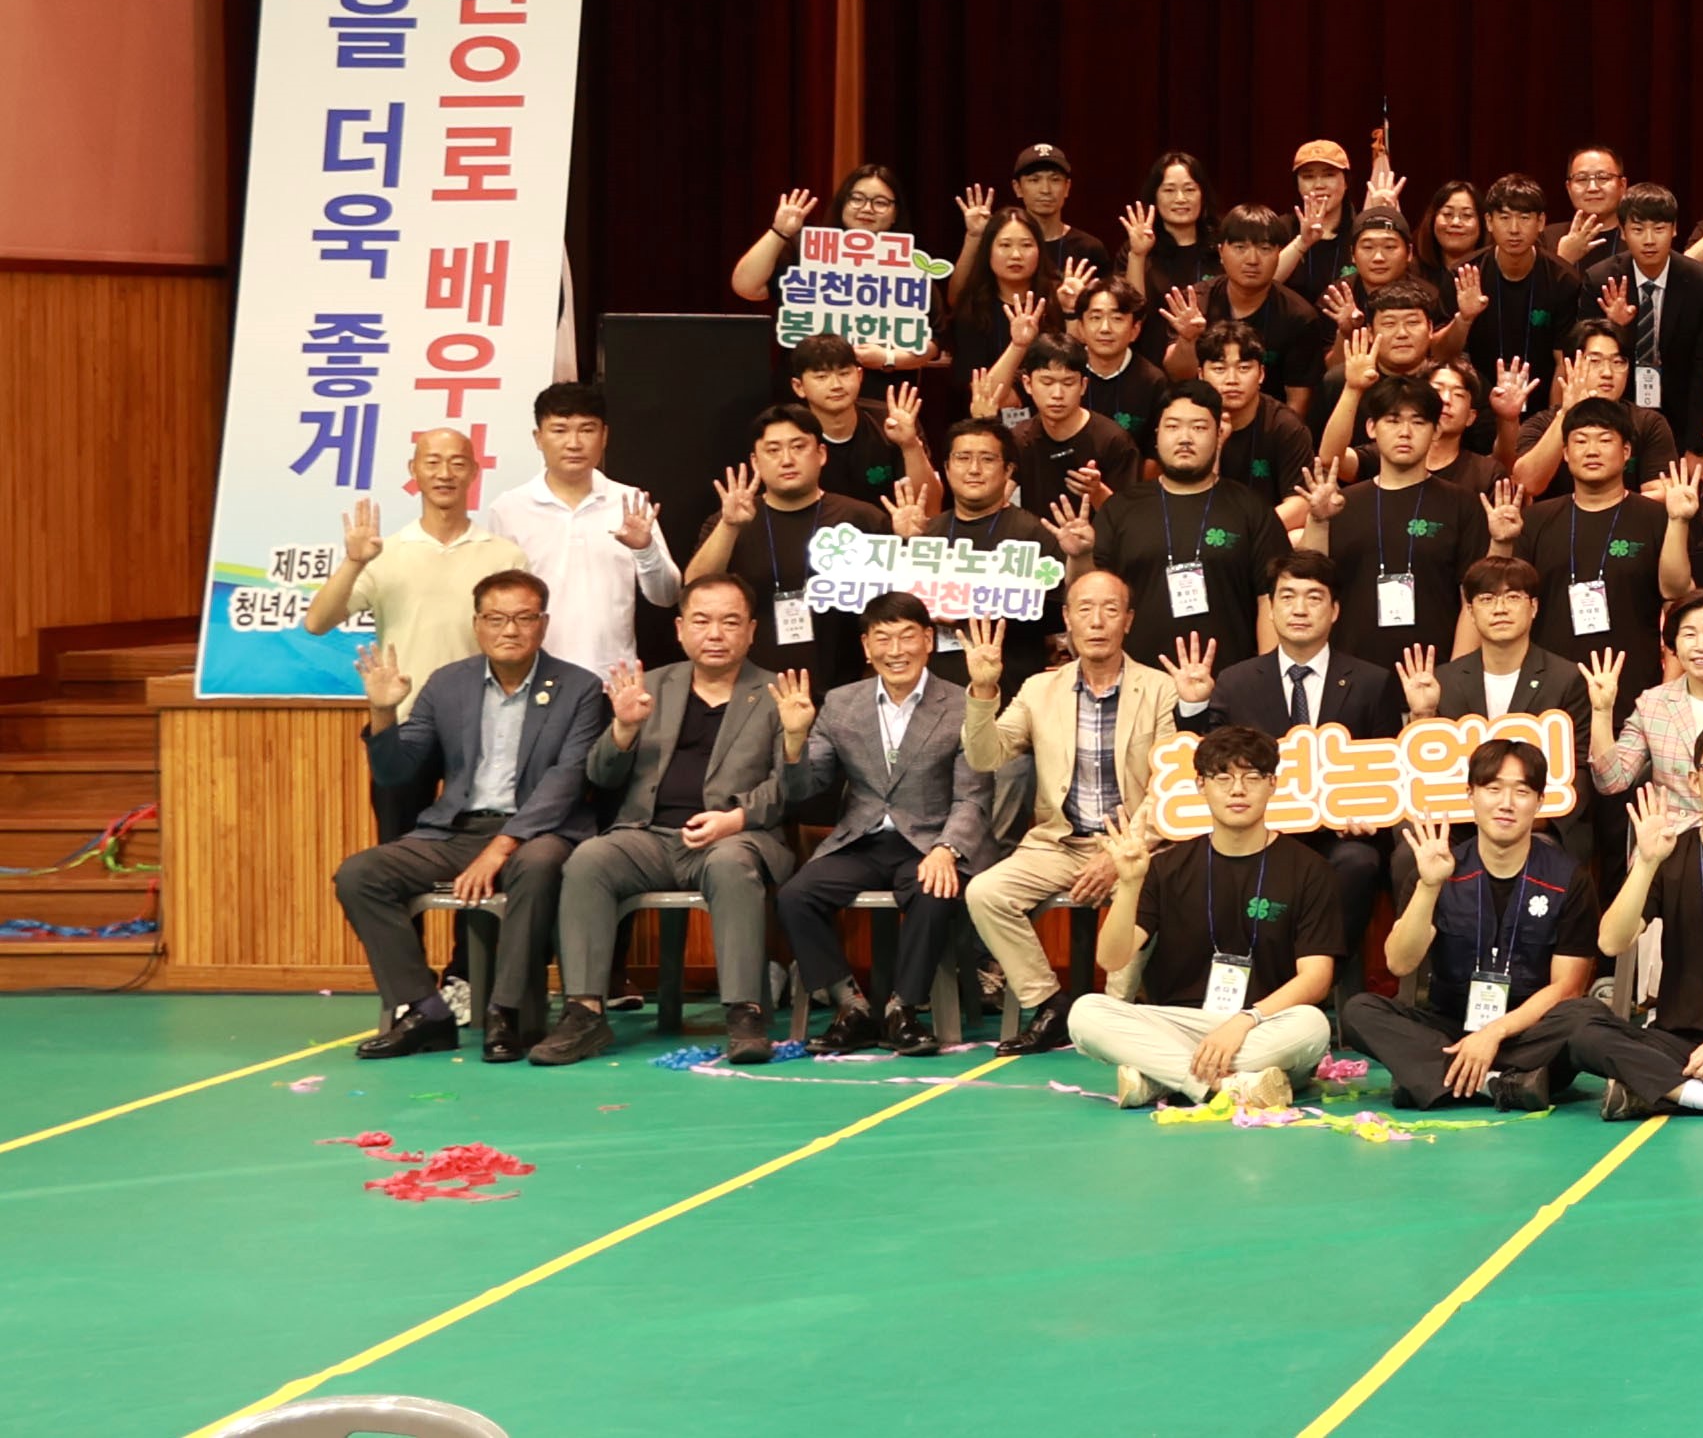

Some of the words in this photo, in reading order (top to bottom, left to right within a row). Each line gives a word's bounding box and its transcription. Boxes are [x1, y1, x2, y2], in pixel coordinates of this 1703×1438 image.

[311, 102, 407, 282] 더욱
[803, 229, 912, 268] 배우고
[780, 265, 931, 312] 실천하며
[777, 307, 930, 352] 봉사한다
[289, 312, 391, 491] 좋게
[270, 546, 335, 584] 제5회
[907, 580, 1043, 616] 실천한다!
